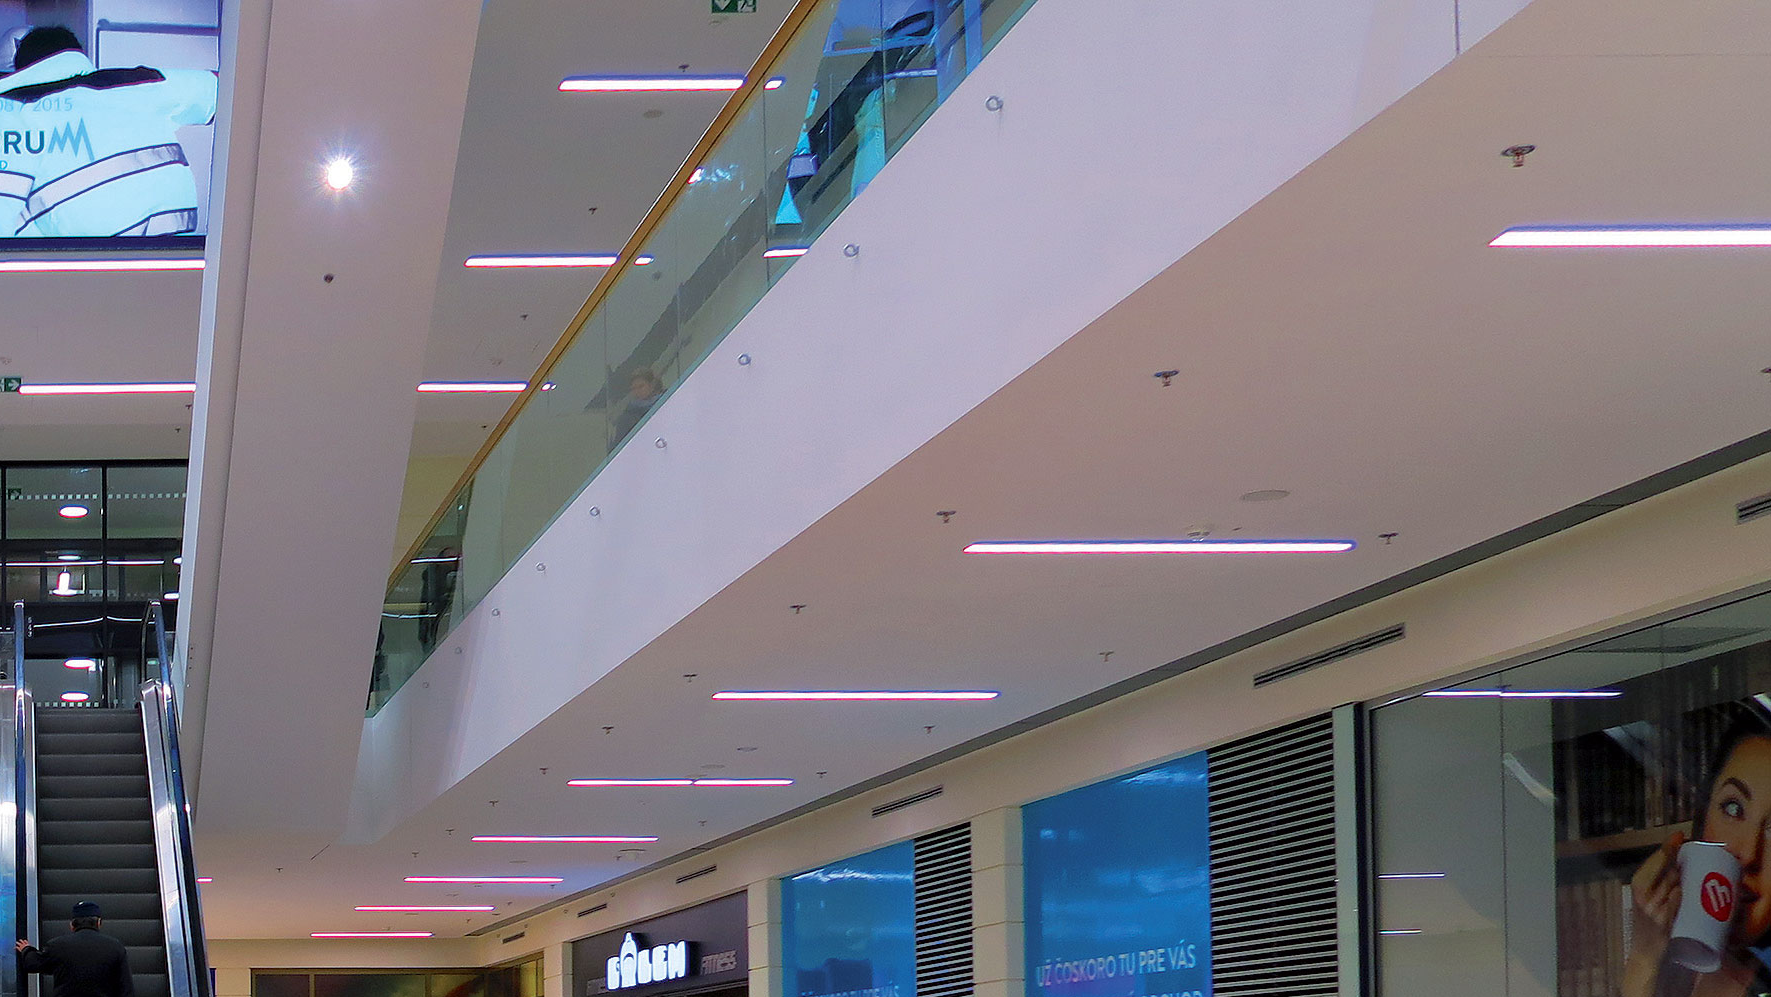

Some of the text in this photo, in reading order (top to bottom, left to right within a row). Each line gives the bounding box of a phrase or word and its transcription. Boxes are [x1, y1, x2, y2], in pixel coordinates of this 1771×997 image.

[33, 97, 73, 112] 2015
[1055, 956, 1117, 985] ČOSKORO
[1119, 952, 1136, 977] TU
[1139, 948, 1166, 974] PRE
[1167, 939, 1197, 970] VÁS
